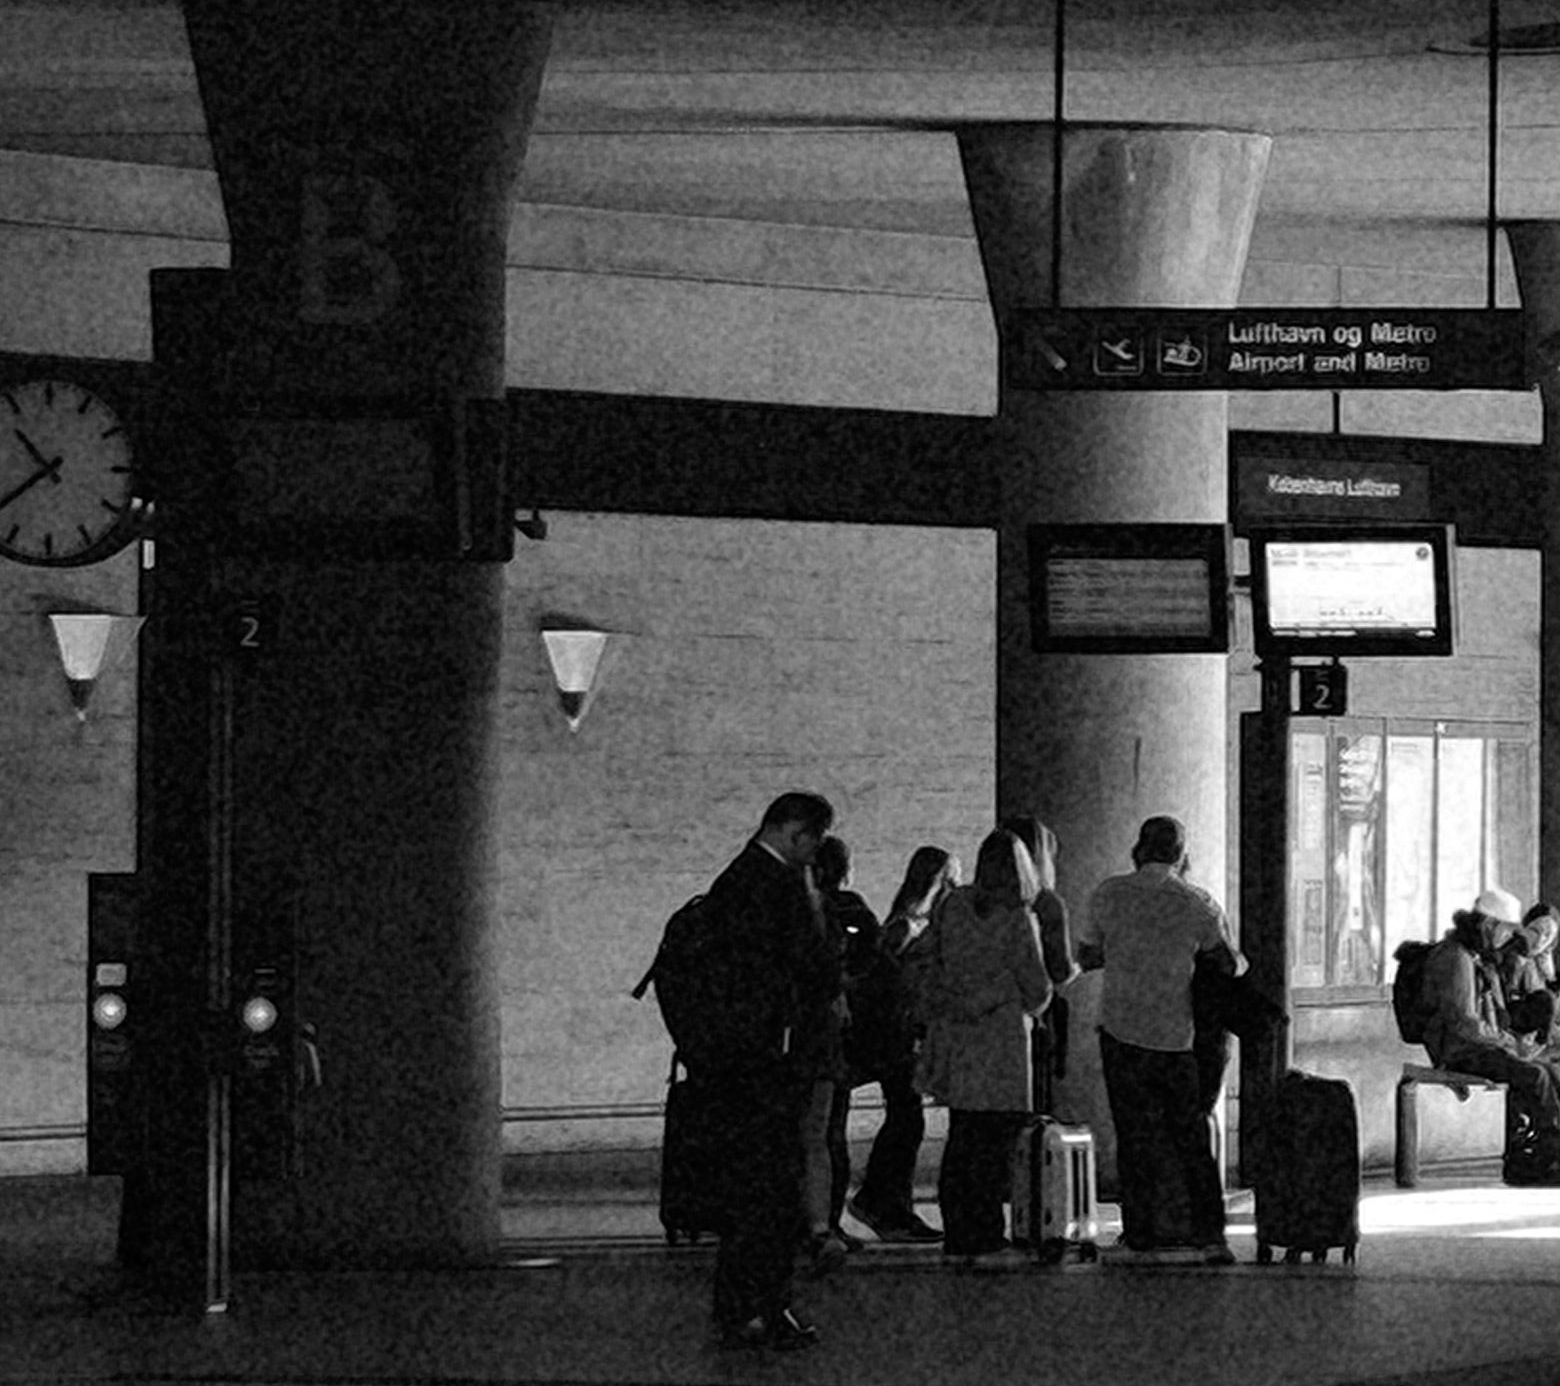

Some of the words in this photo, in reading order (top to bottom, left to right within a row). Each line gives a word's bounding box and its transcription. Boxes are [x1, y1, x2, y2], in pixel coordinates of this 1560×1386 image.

[299, 172, 400, 325] B
[1228, 322, 1326, 344] Lufthavn
[1333, 326, 1362, 348] og
[1370, 323, 1437, 344] Metro
[1228, 351, 1305, 375] Airport
[1313, 352, 1356, 372] and
[1364, 352, 1431, 373] Metro
[240, 615, 260, 648] 2
[1313, 684, 1332, 709] 2
